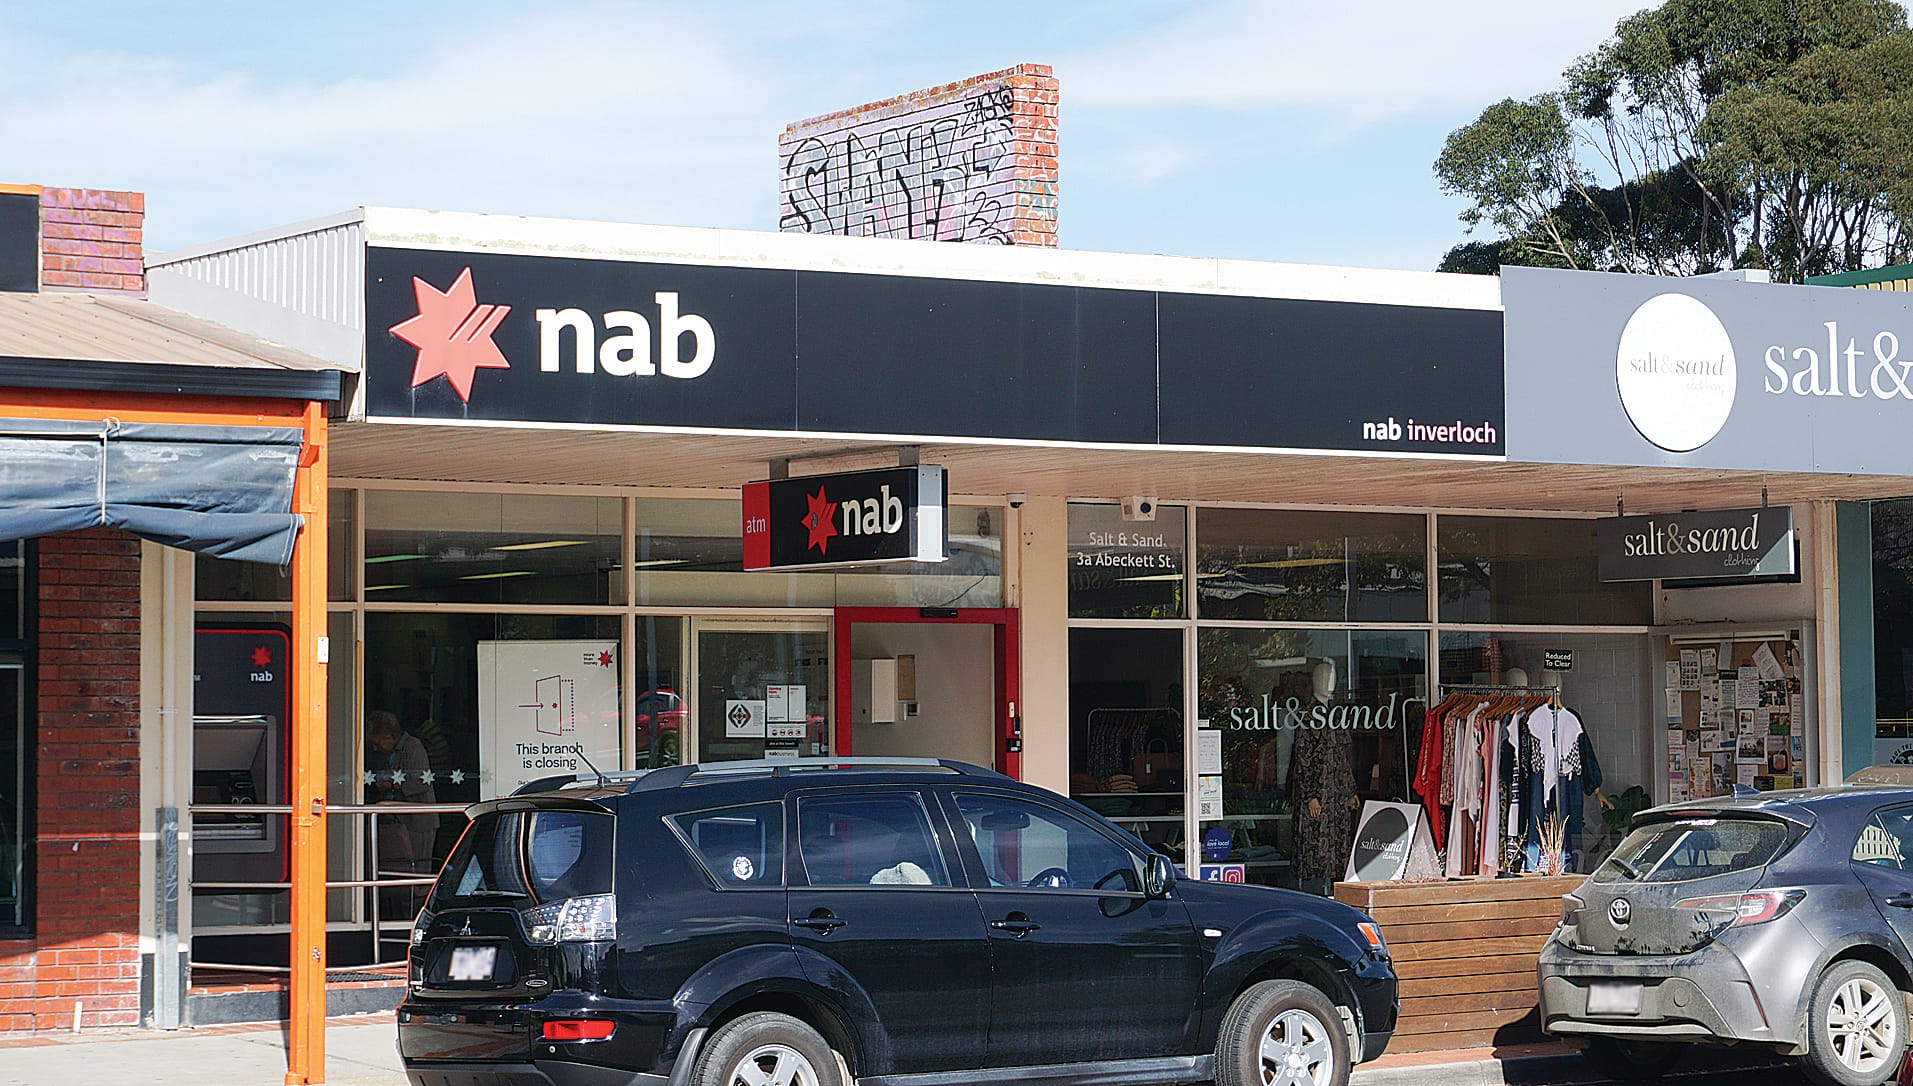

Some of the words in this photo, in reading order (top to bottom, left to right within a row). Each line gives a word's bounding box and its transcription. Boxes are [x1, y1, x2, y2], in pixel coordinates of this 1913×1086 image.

[536, 292, 716, 379] nab
[1630, 352, 1725, 376] salt&sand
[1363, 417, 1402, 440] nab
[1407, 419, 1496, 443] inverloch
[842, 484, 903, 536] nab
[746, 517, 766, 533] atm
[1089, 532, 1114, 546] Salt
[1118, 533, 1127, 546] &
[1132, 534, 1167, 547] Sand.
[1625, 512, 1760, 557] salt&sand
[1077, 552, 1092, 566] 3a
[1095, 553, 1154, 567] Abeckett
[1158, 554, 1175, 568] St.
[1545, 652, 1571, 660] Reduced
[250, 671, 274, 682] nab
[1230, 692, 1398, 730] salt&sand
[516, 743, 539, 755] This
[542, 742, 583, 755] branch
[523, 757, 532, 768] is
[535, 757, 577, 770] closing
[1360, 837, 1404, 853] salt&sand
